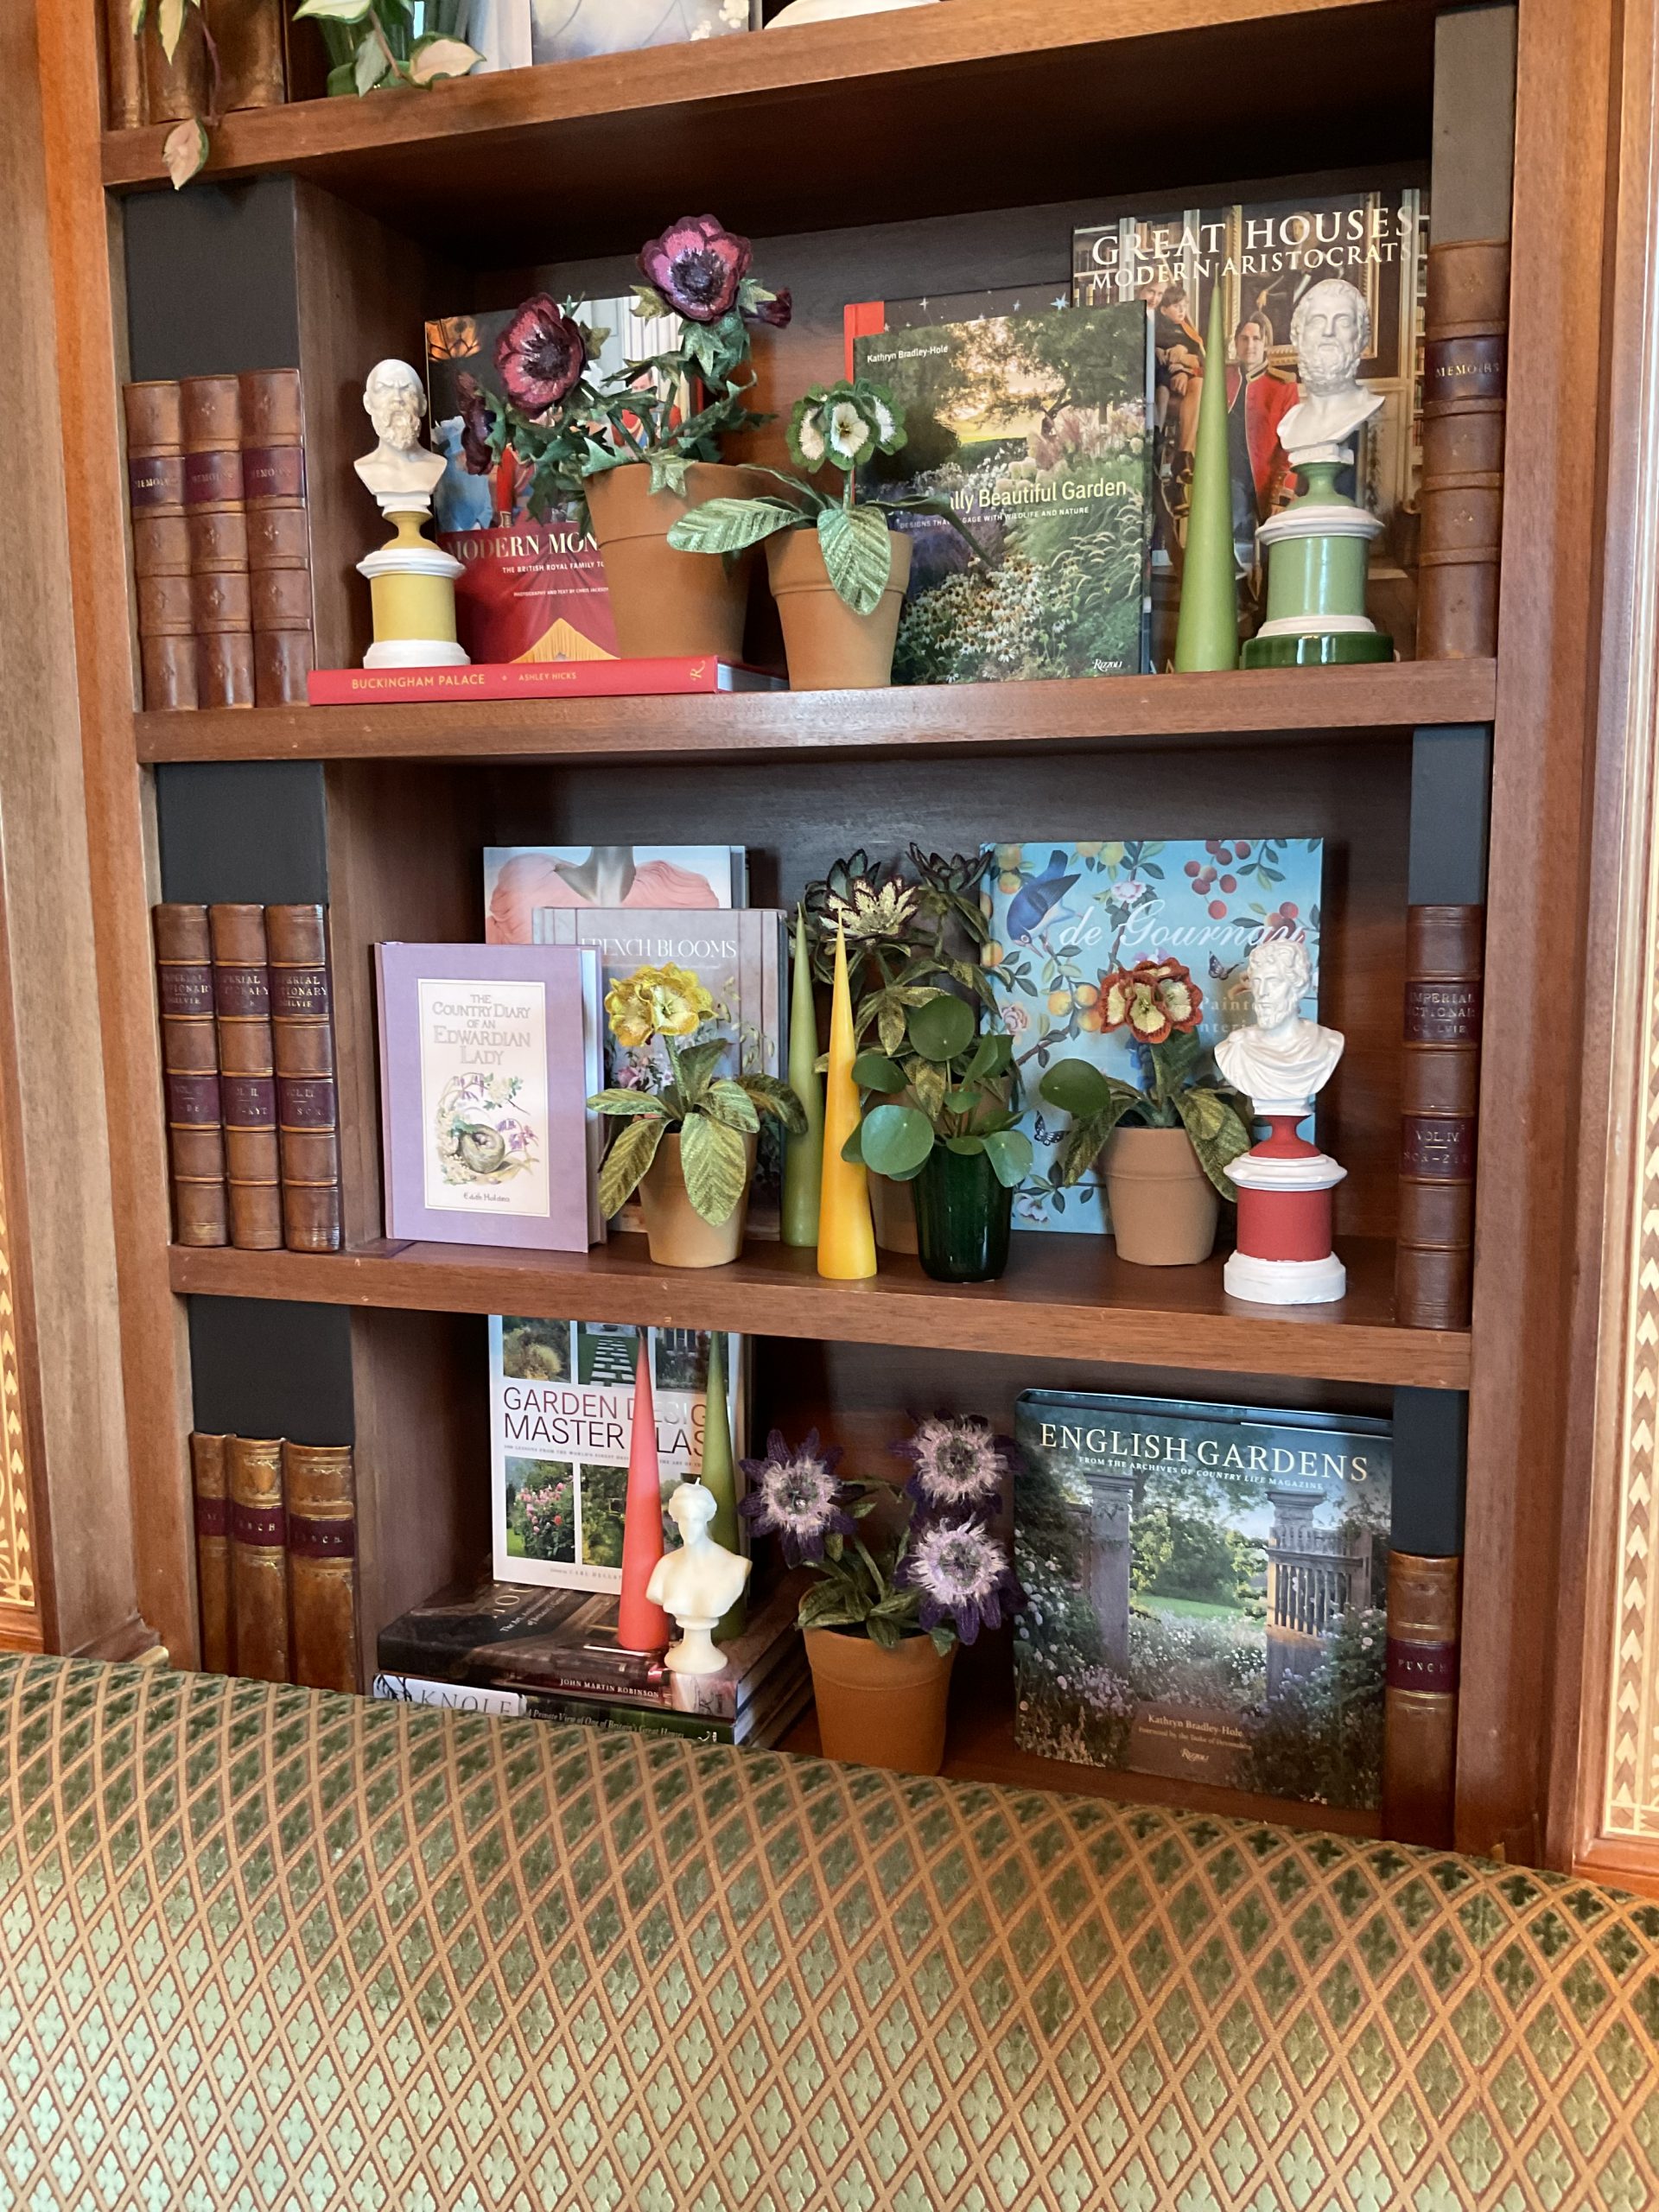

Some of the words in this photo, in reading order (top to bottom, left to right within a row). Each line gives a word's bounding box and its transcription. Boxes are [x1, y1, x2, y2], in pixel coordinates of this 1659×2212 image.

[1092, 223, 1226, 265] GREAT
[1245, 206, 1413, 250] HOUSES
[1092, 259, 1218, 289] MODERN
[1221, 241, 1412, 276] ARISTOCRATS
[867, 353, 896, 363] Kathryn
[898, 345, 949, 359] Bradley-Hole
[980, 483, 1057, 508] Beautiful
[1062, 479, 1127, 500] Garden
[900, 520, 931, 529] DESIGNS
[1004, 511, 1039, 520] WILDLIFE
[1058, 506, 1090, 515] NATURE
[448, 535, 539, 562] MODERN
[549, 531, 601, 554] MON
[518, 564, 544, 573] BRITISH
[570, 562, 594, 570] FAMILY
[352, 677, 434, 690] BUCKINGHAM
[439, 674, 485, 686] PALACE
[518, 672, 549, 682] ASHLEY
[552, 671, 577, 681] HICKS
[1058, 906, 1103, 945] de
[658, 939, 737, 958] BLOOMS
[470, 995, 492, 1003] THE
[467, 1020, 480, 1028] OF
[482, 1020, 496, 1028] AN
[504, 1387, 618, 1420] GARDEN
[505, 1413, 625, 1450] MASTER
[1039, 1423, 1188, 1463] ENGLISH
[1197, 1440, 1369, 1482] GARDENS
[1079, 1456, 1105, 1466] FROM
[1108, 1459, 1127, 1468] THE
[1129, 1462, 1178, 1474] ARCHIVES
[1181, 1467, 1193, 1476] OF
[1196, 1469, 1242, 1482] COUNTRY
[1243, 1474, 1266, 1484] LIFE
[1268, 1477, 1324, 1491] MAGAZINE
[560, 1678, 582, 1687] JOHN
[584, 1681, 615, 1692] MARTIN
[617, 1686, 659, 1698] ROBINSON
[533, 1709, 558, 1720] Private
[559, 1713, 576, 1722] View
[577, 1715, 584, 1725] of
[585, 1716, 598, 1726] One
[600, 1719, 607, 1727] of
[1148, 1713, 1183, 1727] Kathryn
